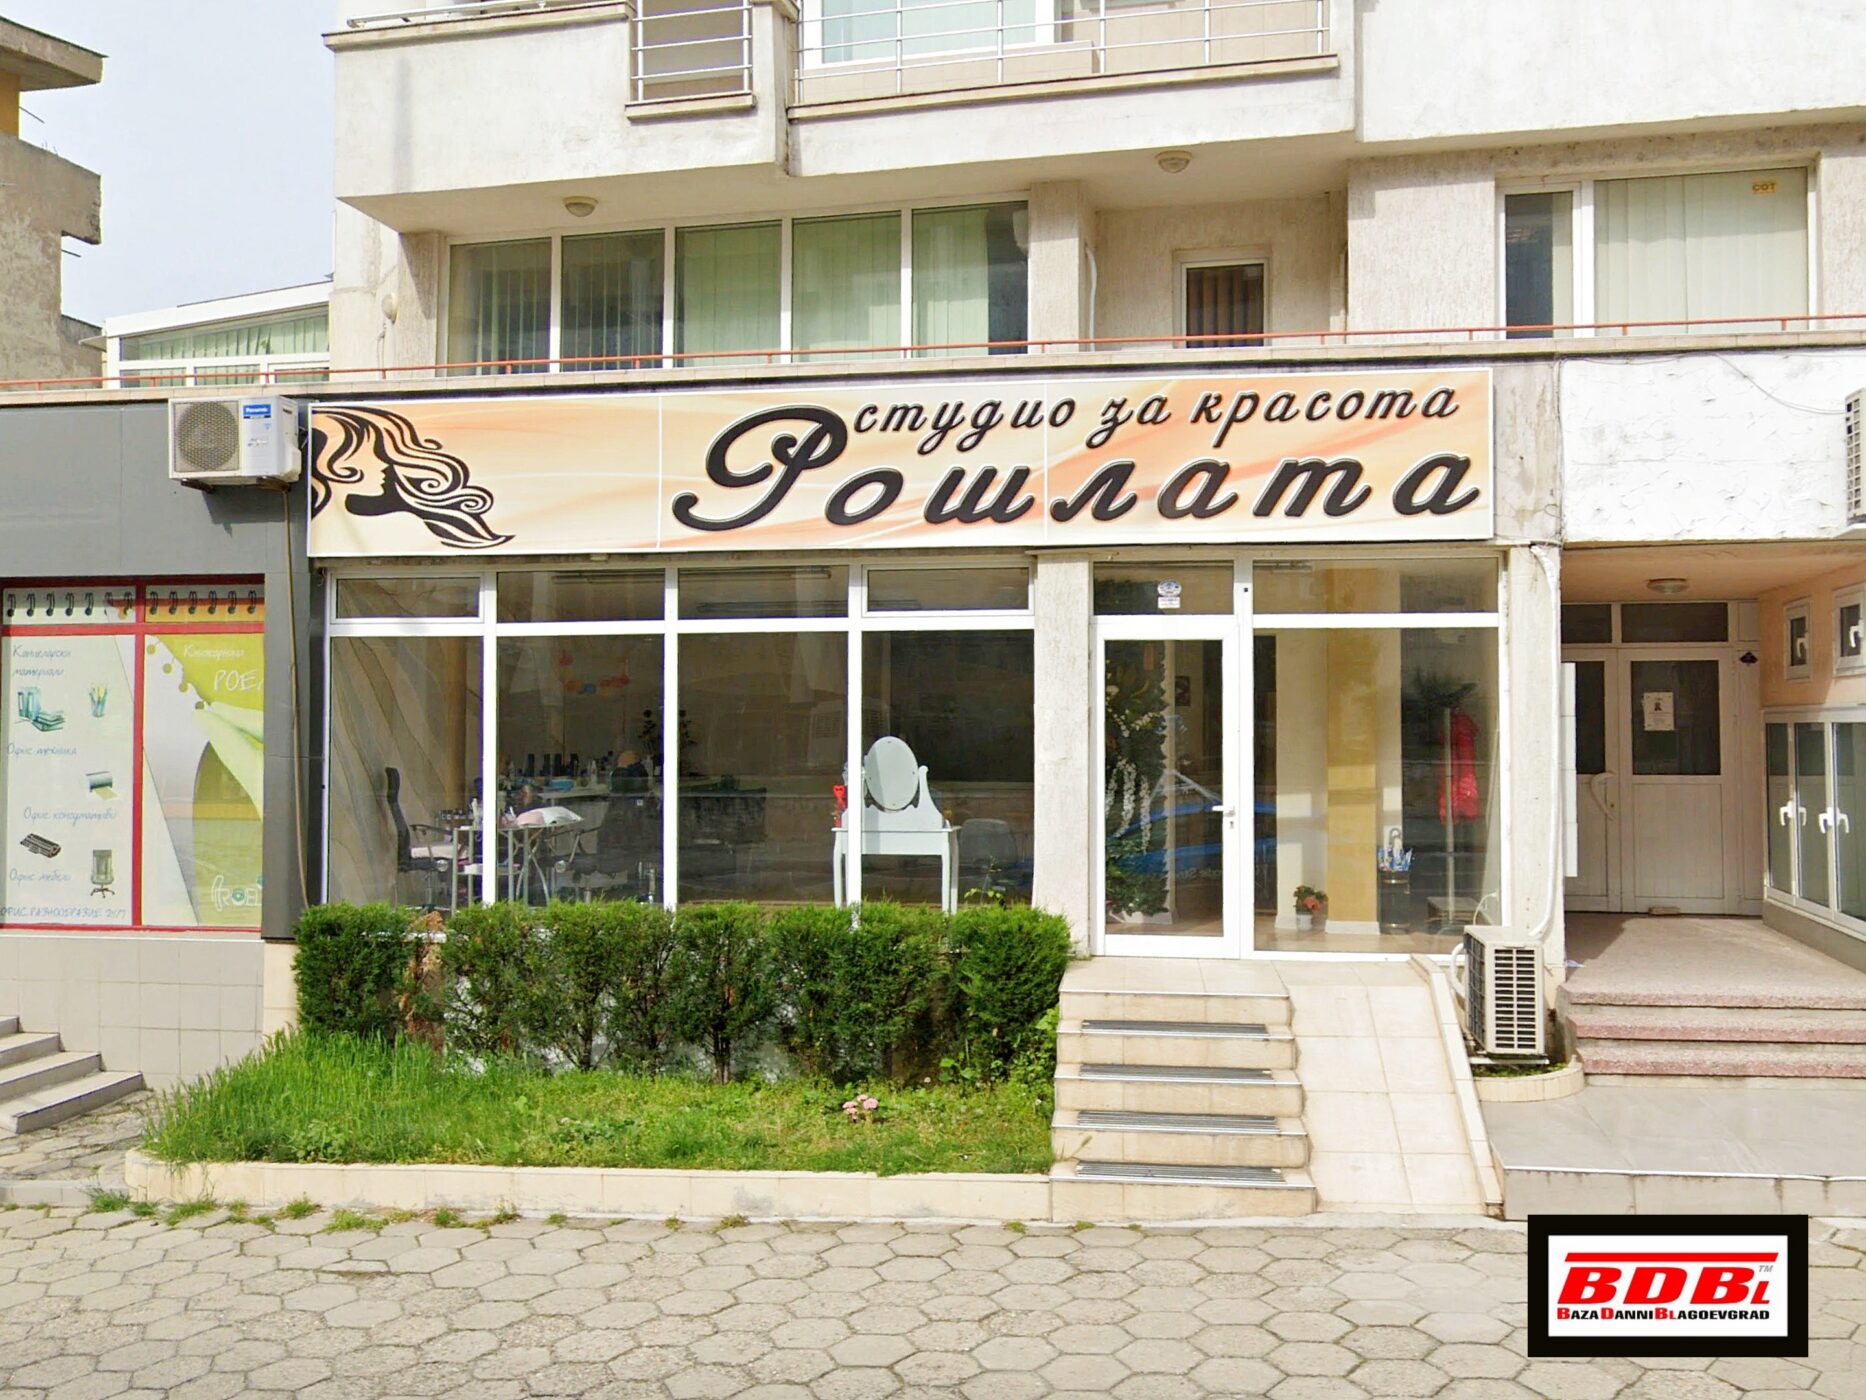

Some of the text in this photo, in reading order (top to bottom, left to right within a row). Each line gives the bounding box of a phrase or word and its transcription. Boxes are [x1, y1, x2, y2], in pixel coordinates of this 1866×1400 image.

[672, 404, 1480, 532] Рошлата
[854, 386, 1460, 455] студио за красота
